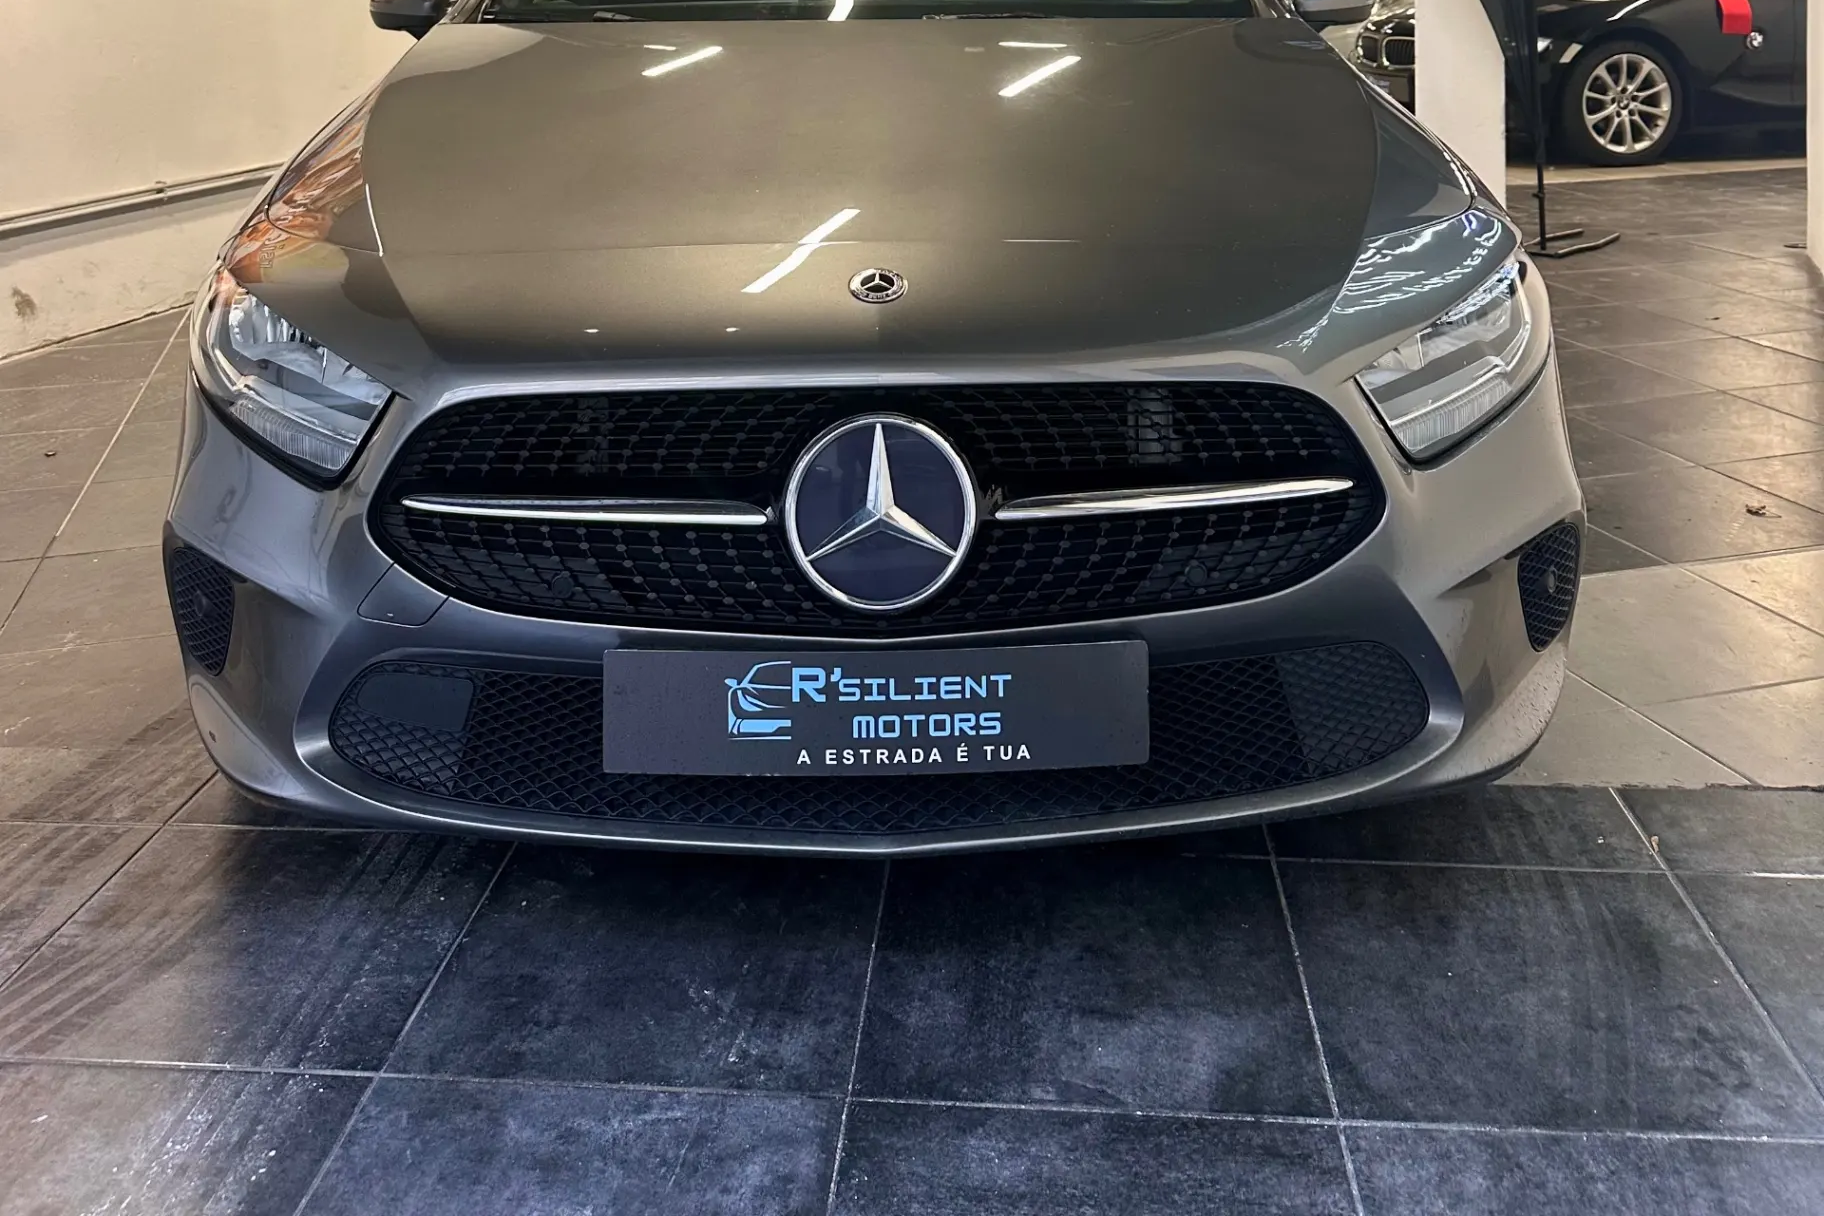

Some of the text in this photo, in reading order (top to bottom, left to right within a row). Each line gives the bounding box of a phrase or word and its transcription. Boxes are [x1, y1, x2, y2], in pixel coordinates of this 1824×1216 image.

[790, 666, 1012, 704] R'SILIENT
[852, 711, 1002, 739] MOTORS
[796, 743, 1032, 766] A ESTRADA É TUA
